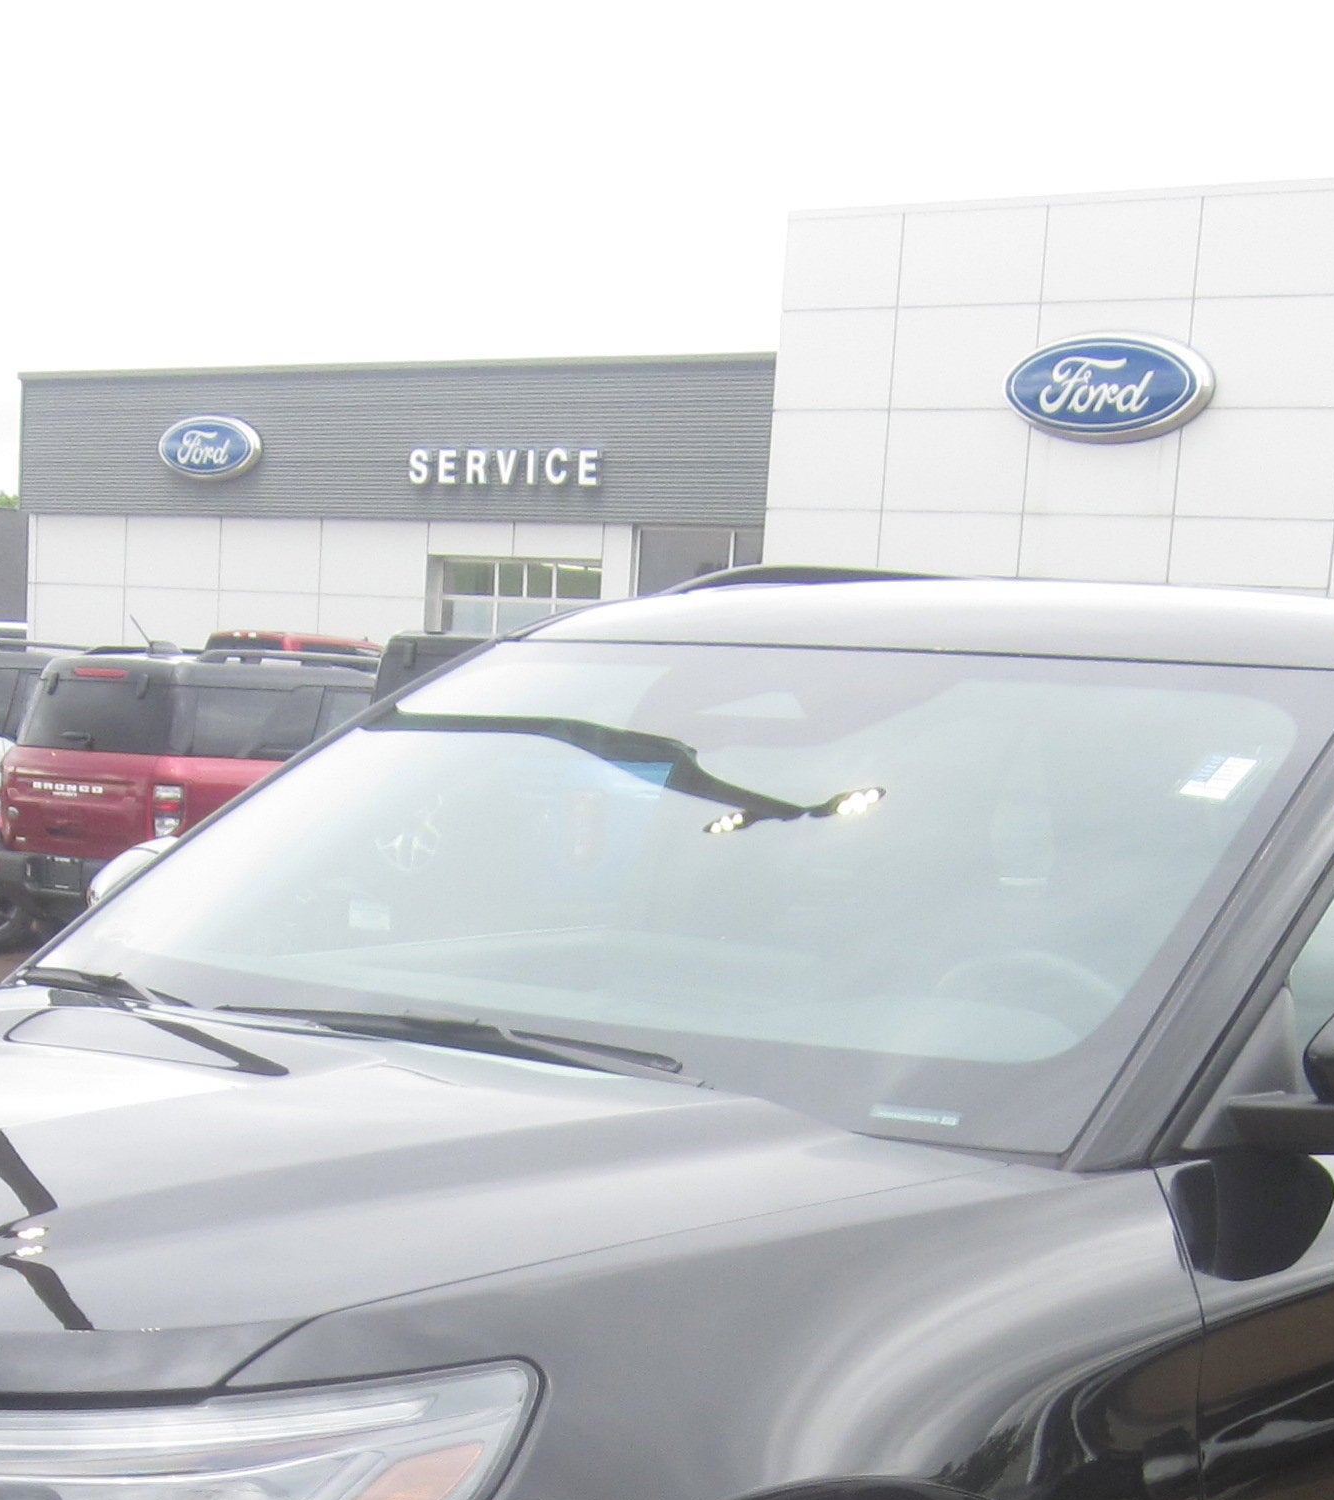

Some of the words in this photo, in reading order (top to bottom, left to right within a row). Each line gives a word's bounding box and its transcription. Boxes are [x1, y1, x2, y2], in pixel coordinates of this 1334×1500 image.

[1039, 356, 1155, 413] Ford
[176, 428, 230, 466] Ford
[408, 447, 599, 486] SERVICE
[32, 781, 103, 794] BRONCO
